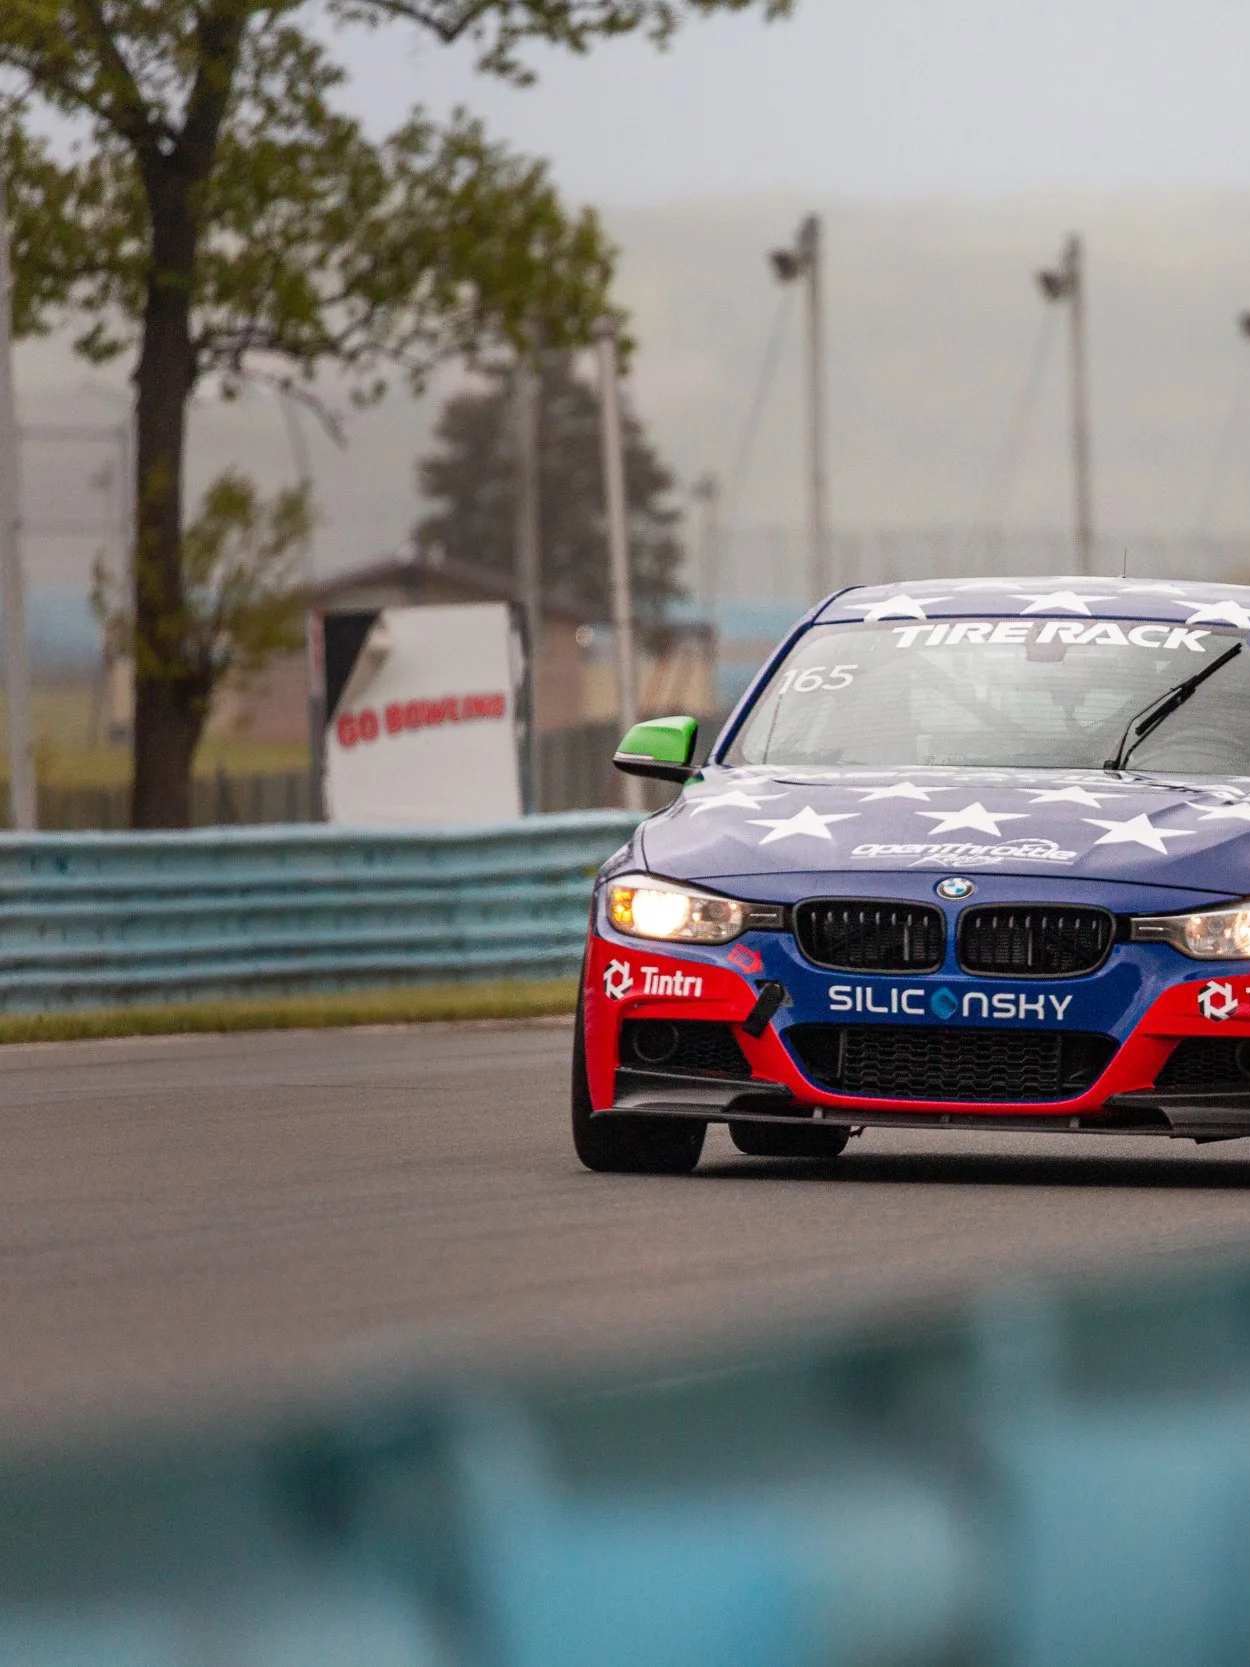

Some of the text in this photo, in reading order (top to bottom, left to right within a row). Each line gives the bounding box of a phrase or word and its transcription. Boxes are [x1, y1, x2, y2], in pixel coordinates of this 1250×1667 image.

[892, 621, 1212, 653] TIRE RACK
[778, 664, 858, 695] 165
[337, 694, 505, 747] GO BOWLING
[640, 966, 703, 997] Tintri
